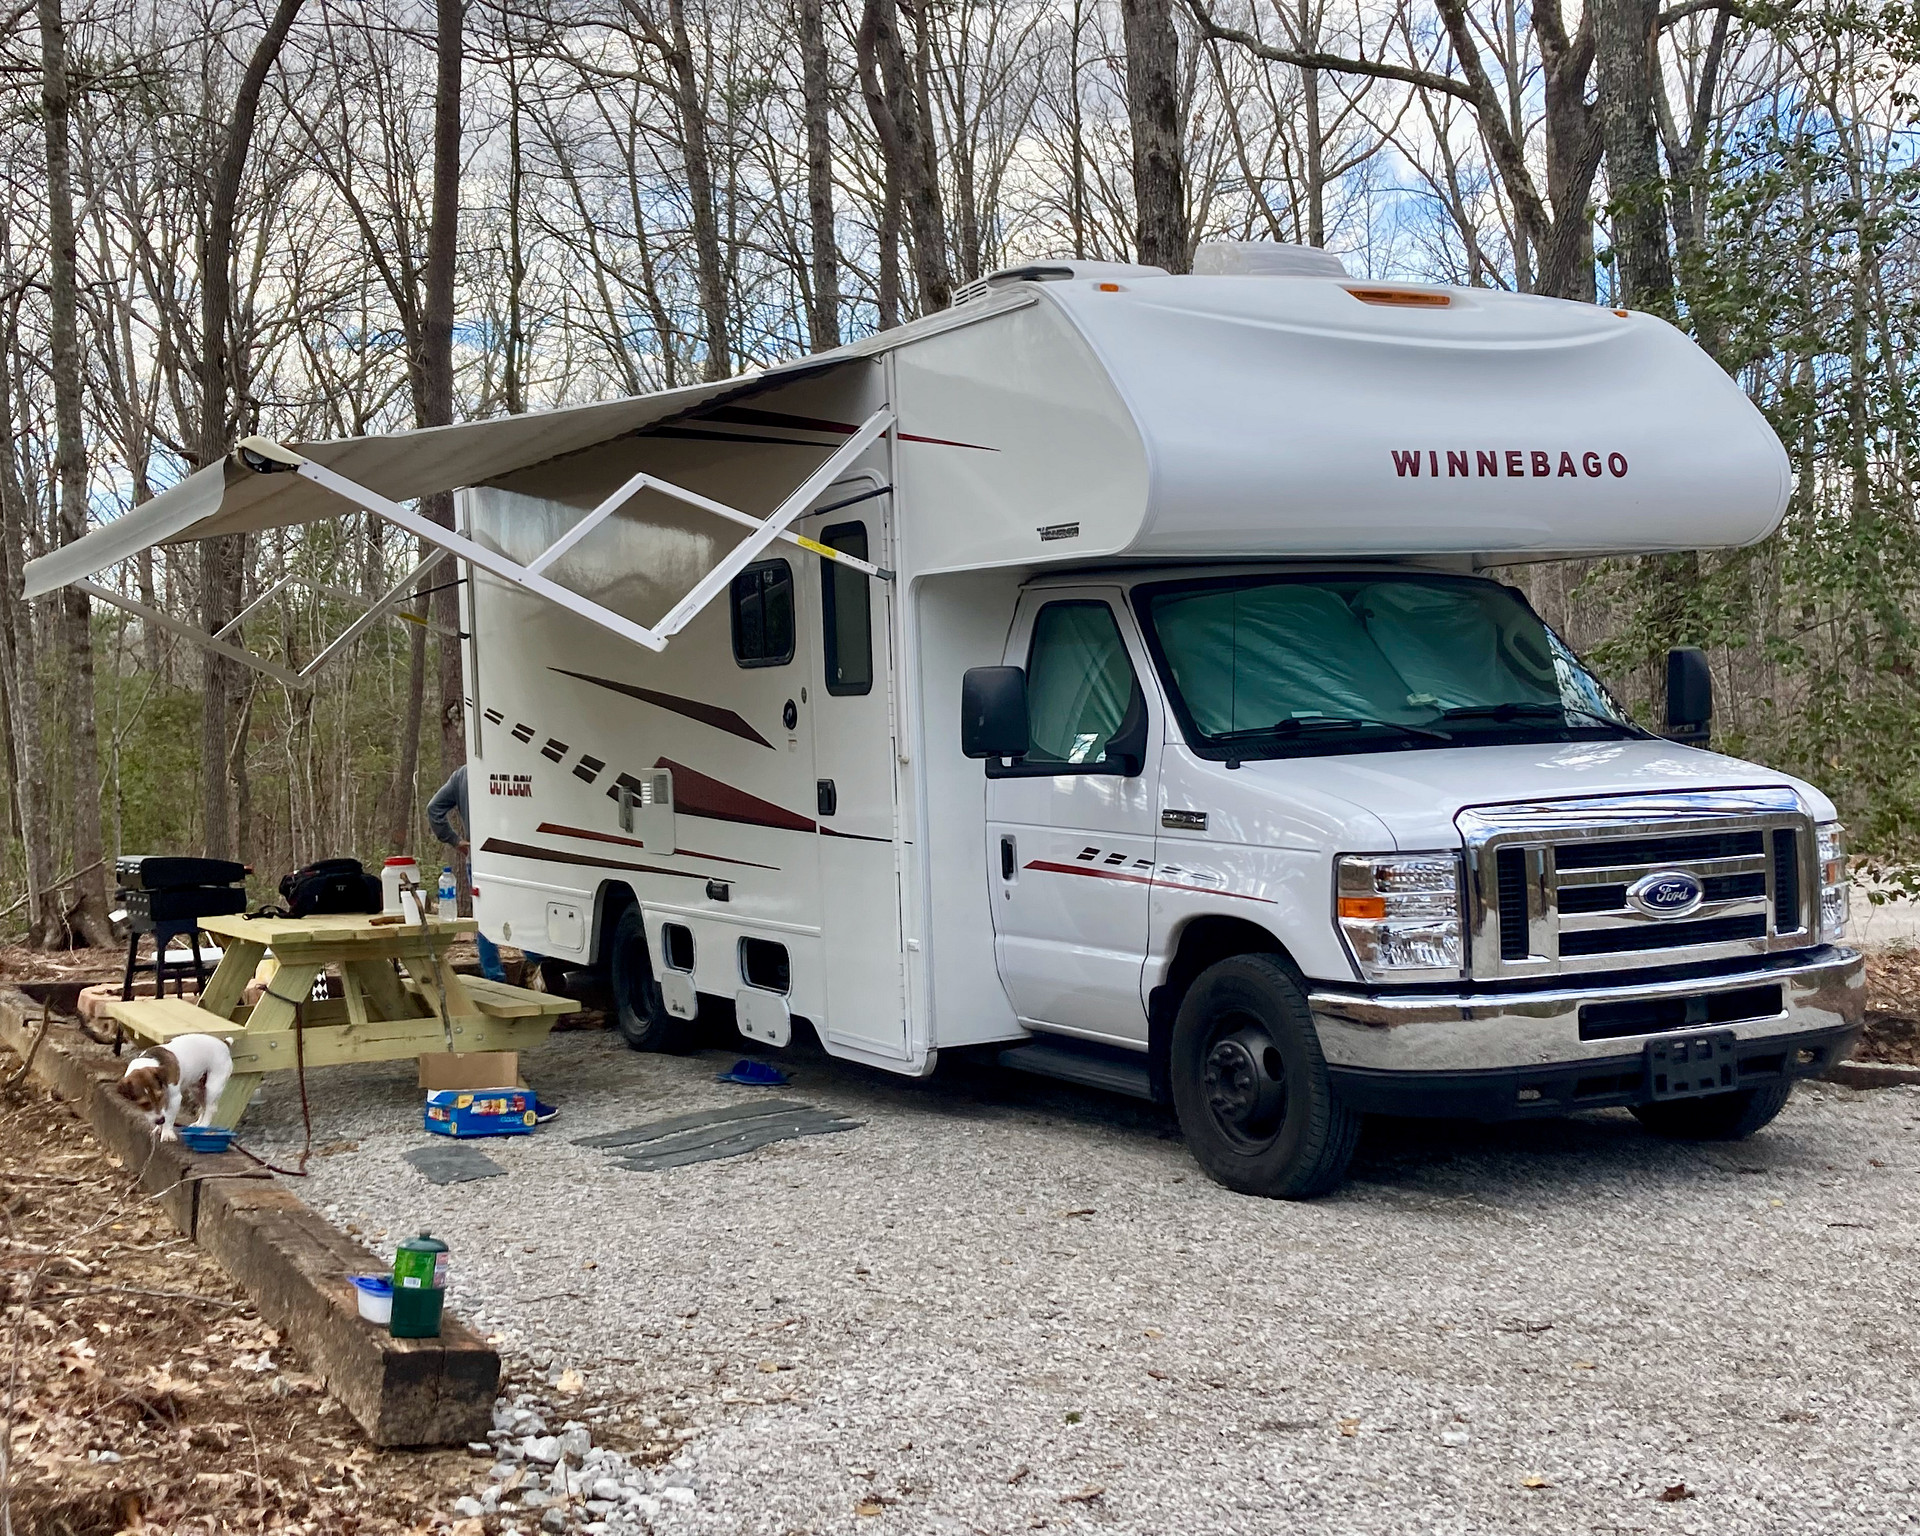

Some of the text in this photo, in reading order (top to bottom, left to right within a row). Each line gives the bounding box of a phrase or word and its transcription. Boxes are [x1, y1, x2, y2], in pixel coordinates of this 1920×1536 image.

[1391, 450, 1629, 478] WINNEBAGO
[489, 773, 533, 798] OUTLOOK
[1656, 883, 1690, 903] Ford
